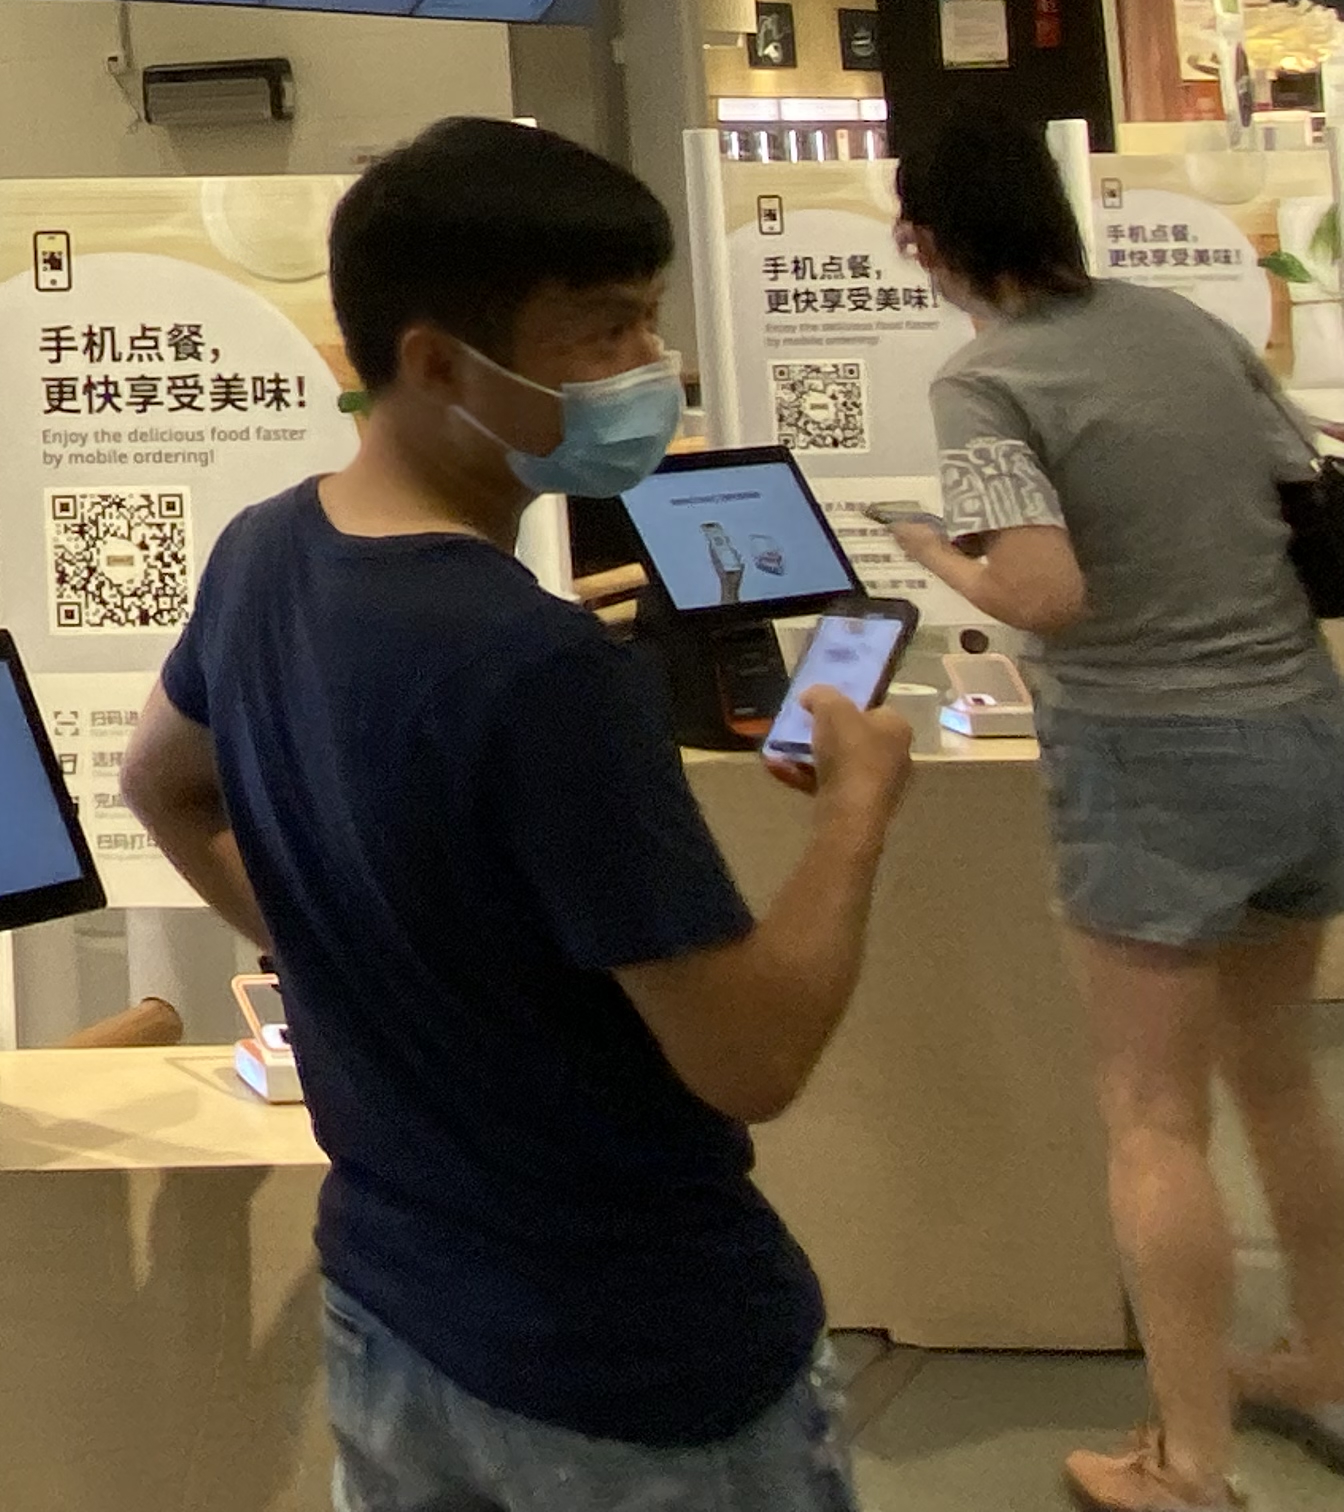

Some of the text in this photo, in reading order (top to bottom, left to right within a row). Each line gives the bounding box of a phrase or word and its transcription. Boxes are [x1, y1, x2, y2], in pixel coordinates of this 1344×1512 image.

[40, 372, 307, 415] 更快享受美味！
[42, 425, 307, 449] Enjoy the delicious food faster
[42, 448, 215, 469] by mobile ordering!
